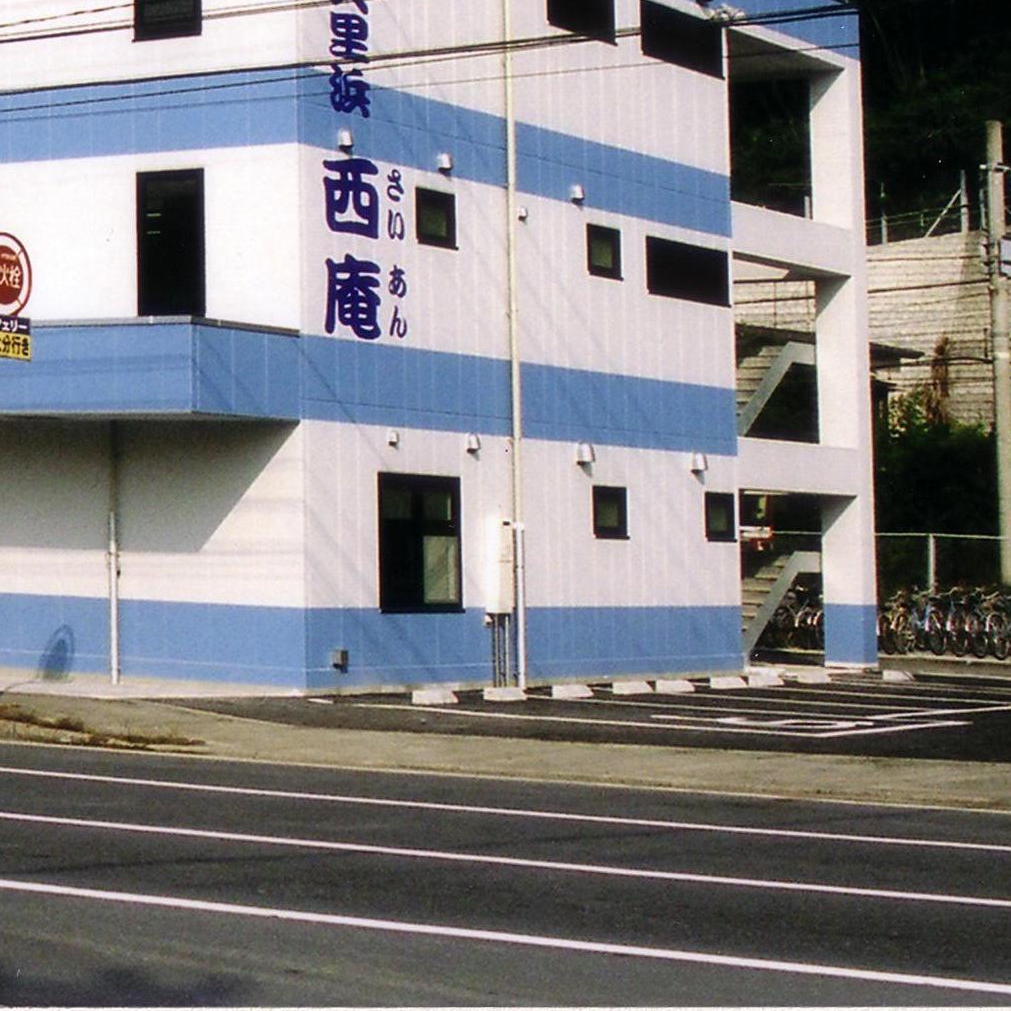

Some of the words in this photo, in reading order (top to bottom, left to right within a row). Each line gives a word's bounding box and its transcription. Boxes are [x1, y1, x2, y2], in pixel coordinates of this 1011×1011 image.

[323, 158, 382, 340] 西庵
[387, 169, 407, 338] さいあん
